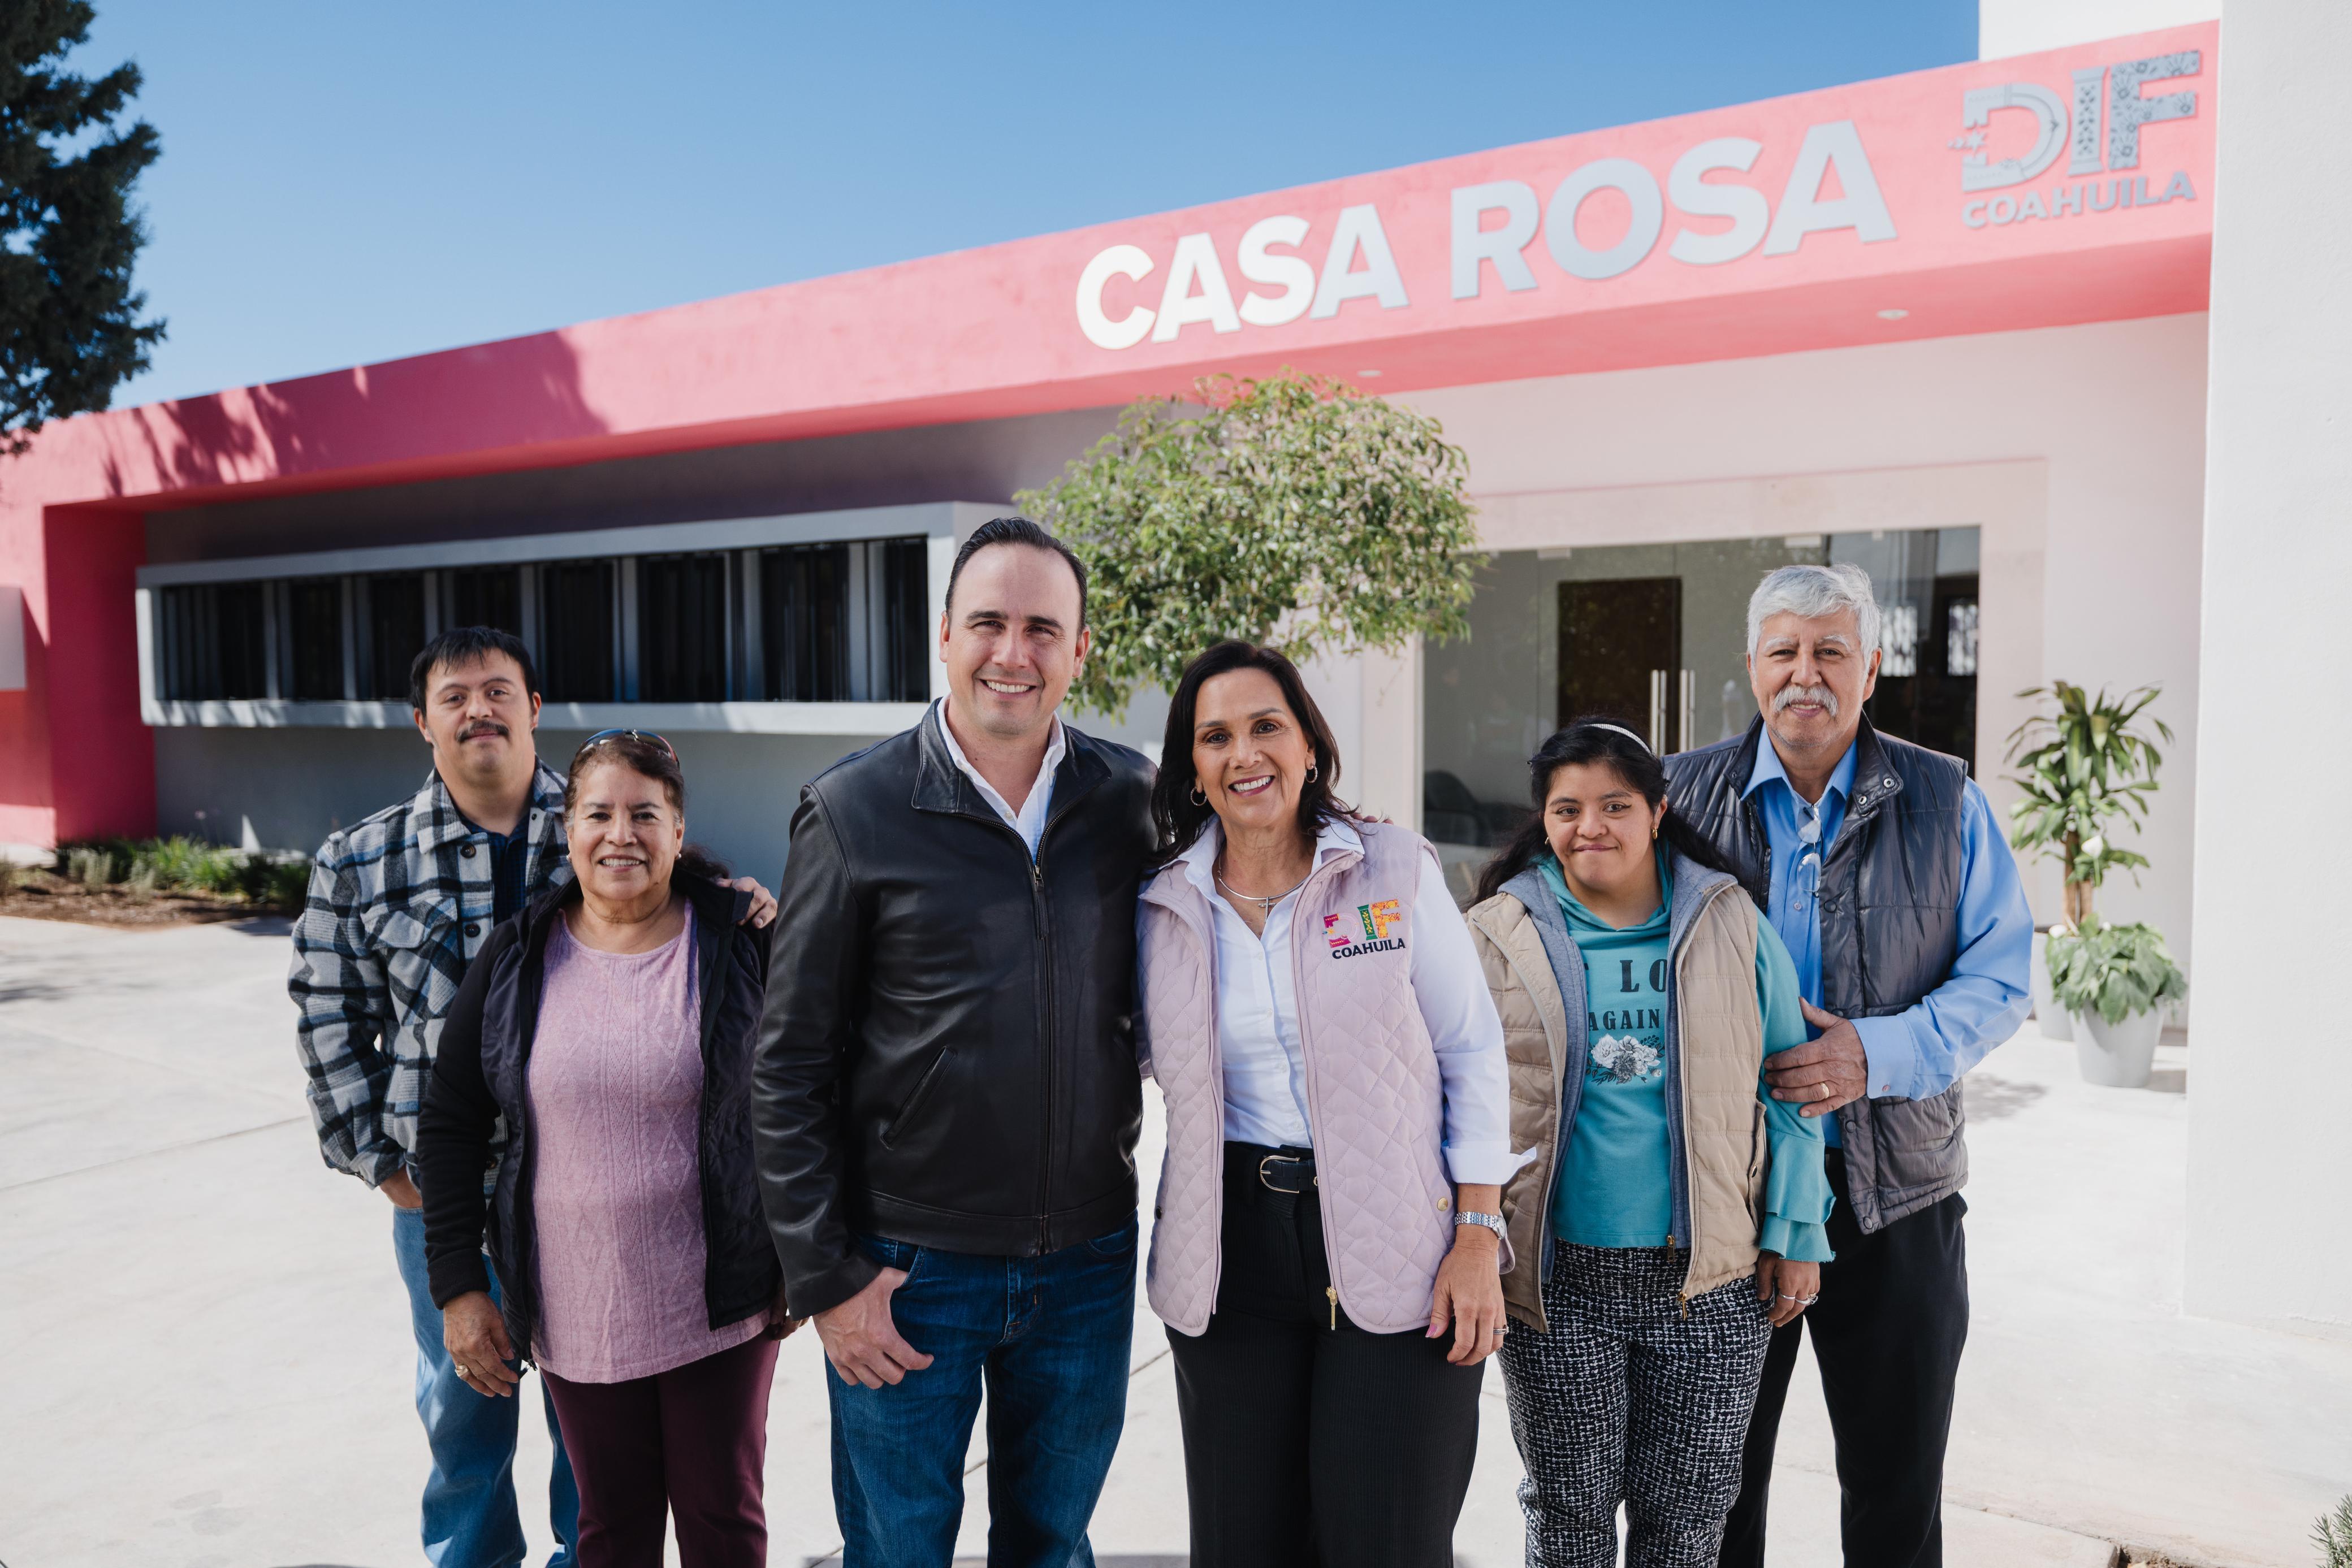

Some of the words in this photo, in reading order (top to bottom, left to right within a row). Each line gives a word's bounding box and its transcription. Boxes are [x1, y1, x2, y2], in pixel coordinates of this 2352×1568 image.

[1961, 50, 2201, 193] DIF
[1961, 170, 2197, 229] COAHUILA
[1075, 202, 1411, 350] CASA
[1450, 119, 1899, 301] ROSA
[1331, 937, 1406, 960] COAHUILA
[1588, 1008, 1661, 1031] AGAIN
